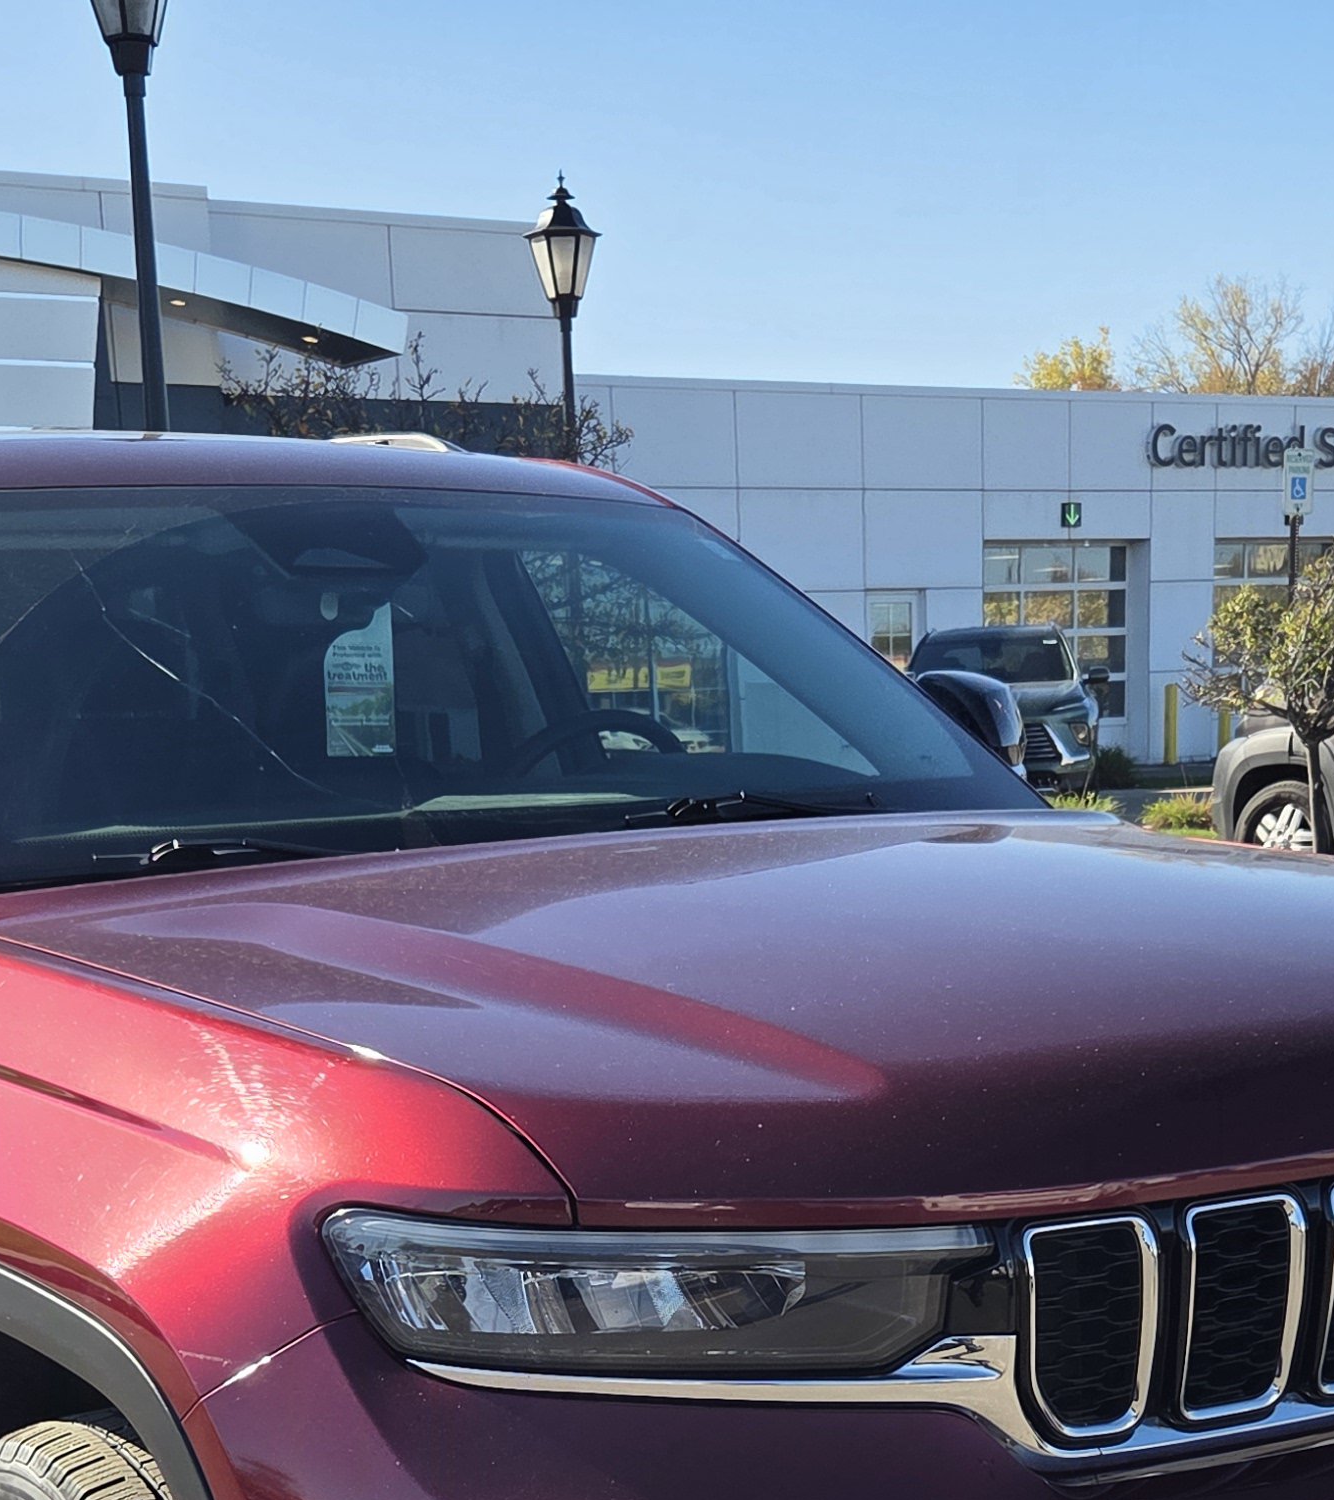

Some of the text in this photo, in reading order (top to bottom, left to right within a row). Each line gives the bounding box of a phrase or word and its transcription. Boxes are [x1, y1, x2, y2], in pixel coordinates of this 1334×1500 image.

[1148, 423, 1305, 468] Certified
[364, 661, 385, 673] the
[327, 670, 388, 682] treatment
